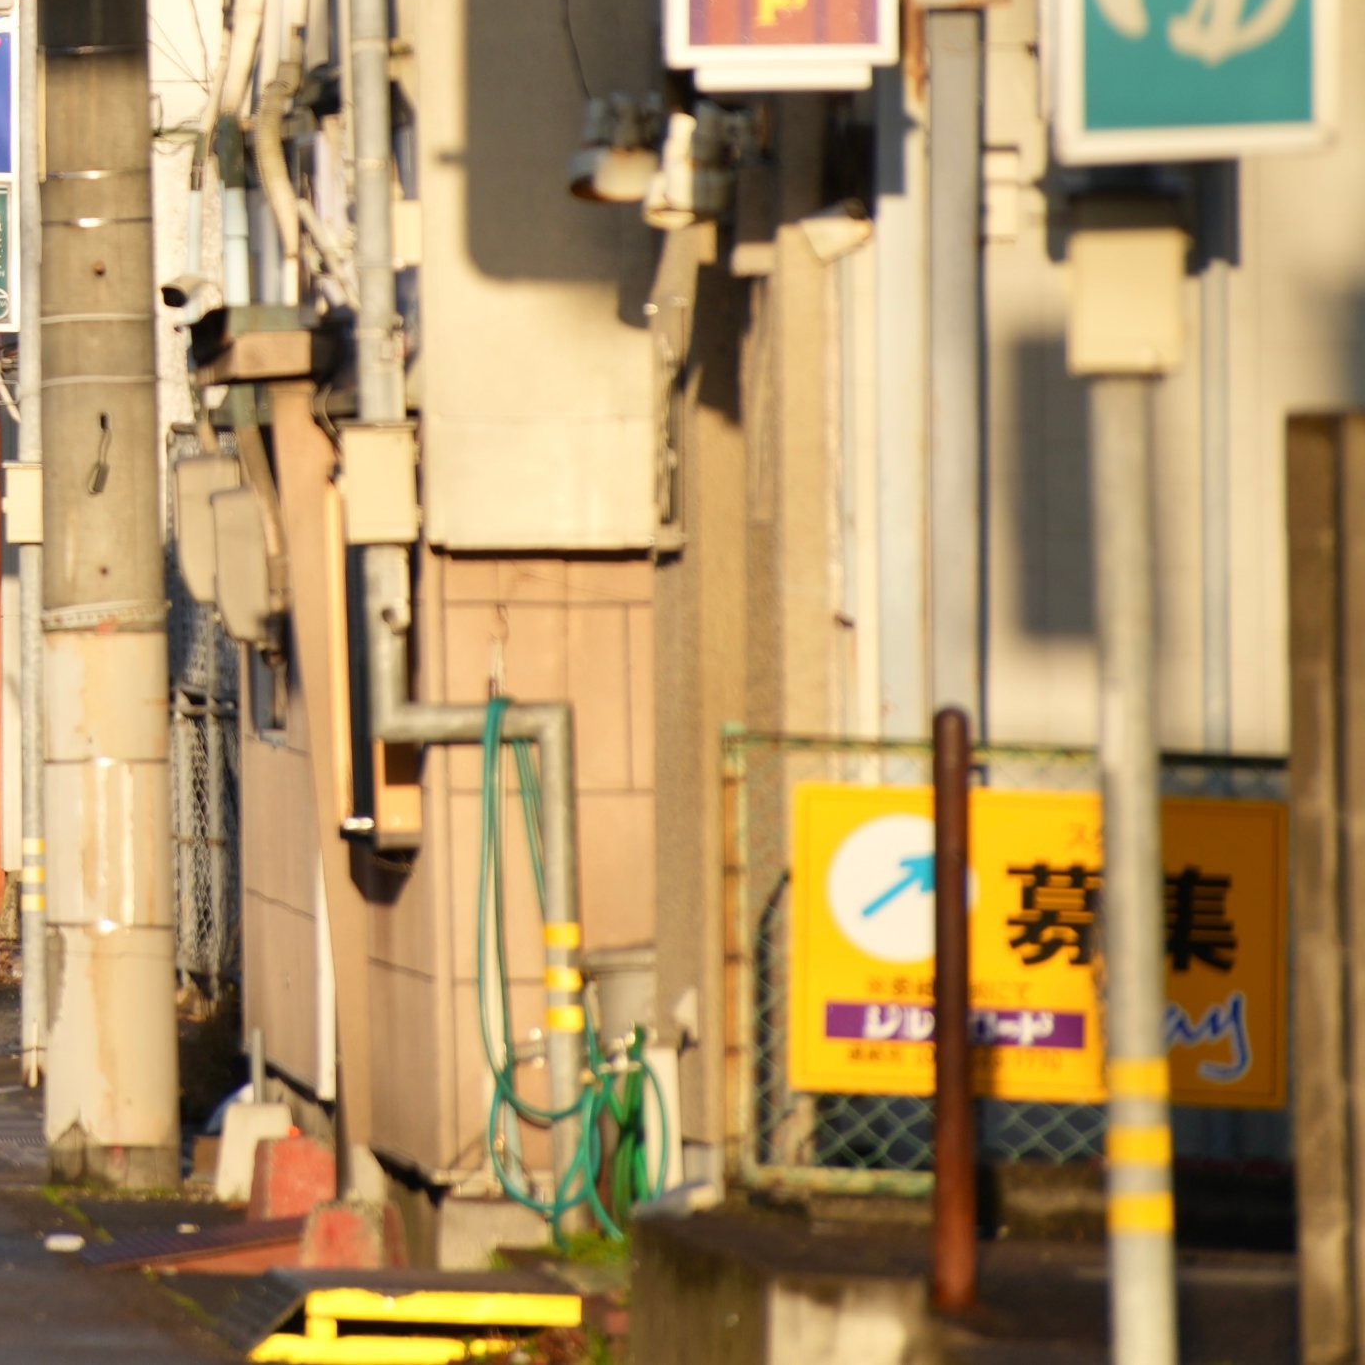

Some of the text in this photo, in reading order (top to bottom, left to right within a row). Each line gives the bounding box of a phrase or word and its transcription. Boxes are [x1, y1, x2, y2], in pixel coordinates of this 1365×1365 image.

[864, 1002, 1056, 1047] シルロード
[1162, 991, 1252, 1082] ay
